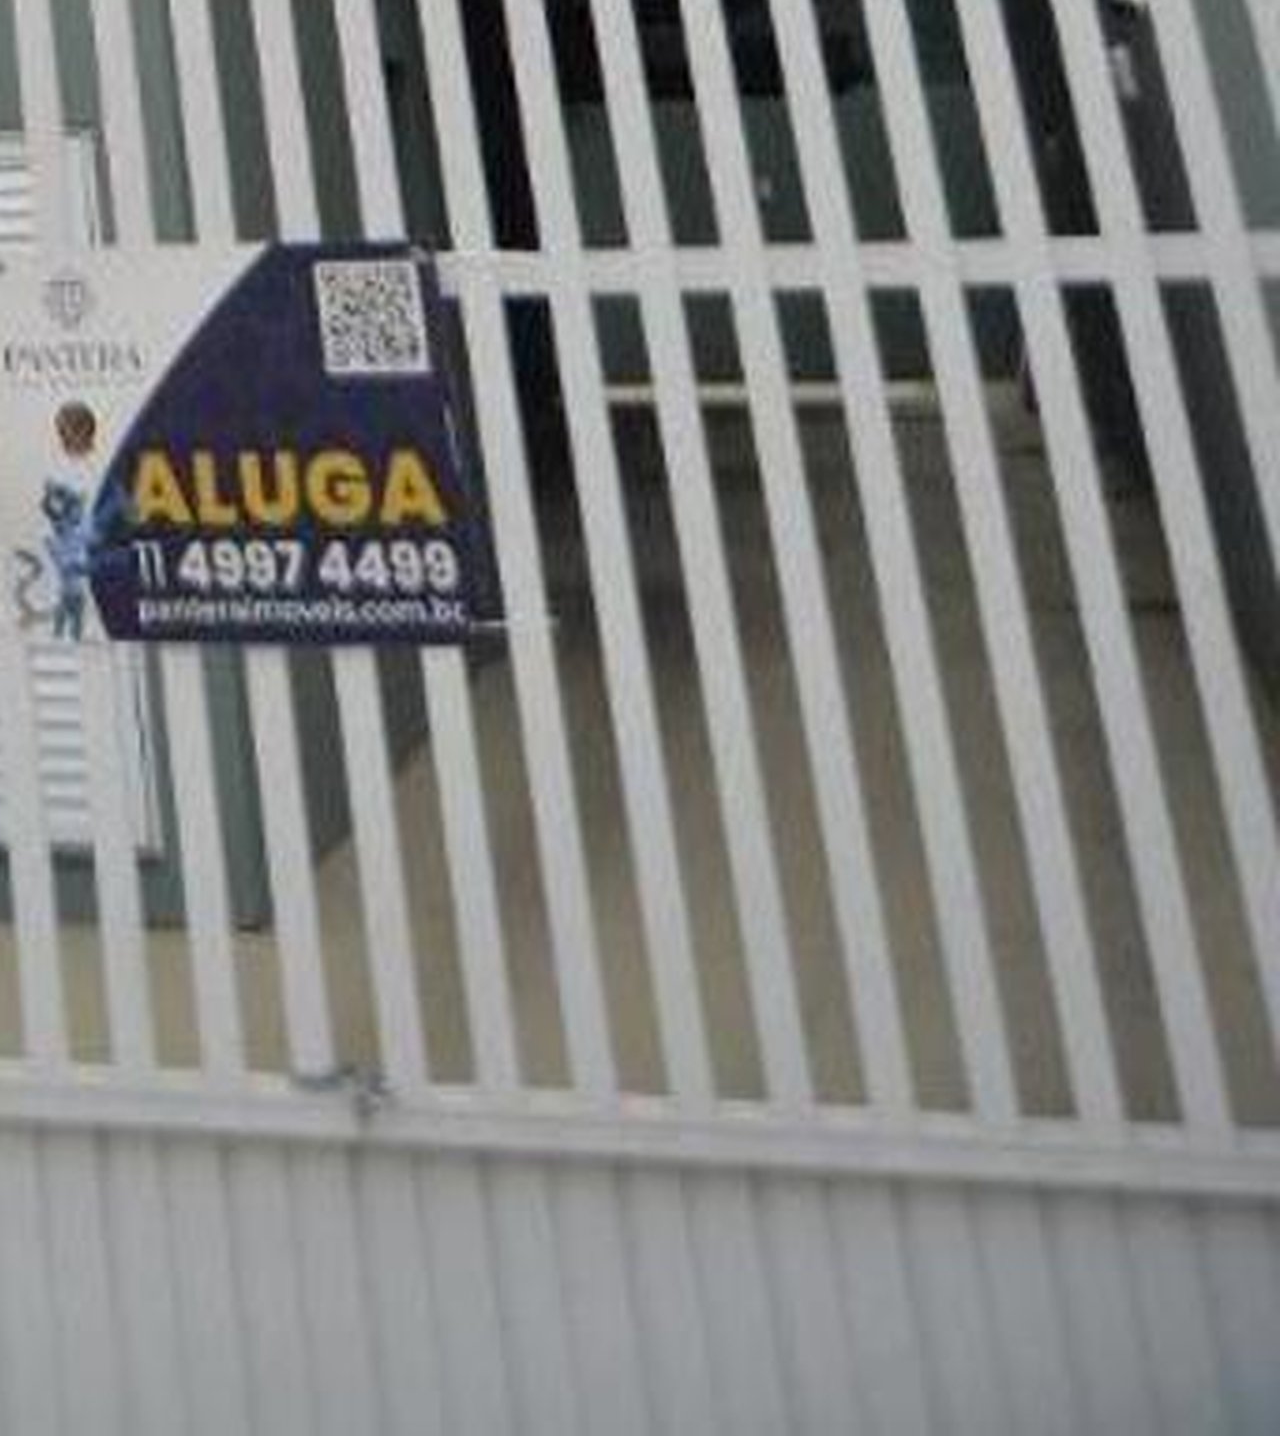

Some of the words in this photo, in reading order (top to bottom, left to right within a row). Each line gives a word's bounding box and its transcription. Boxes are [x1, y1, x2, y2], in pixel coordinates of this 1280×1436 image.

[129, 448, 447, 525] ALUGA
[133, 541, 167, 589] 11
[177, 540, 304, 589] 4997
[318, 540, 458, 590] 4499
